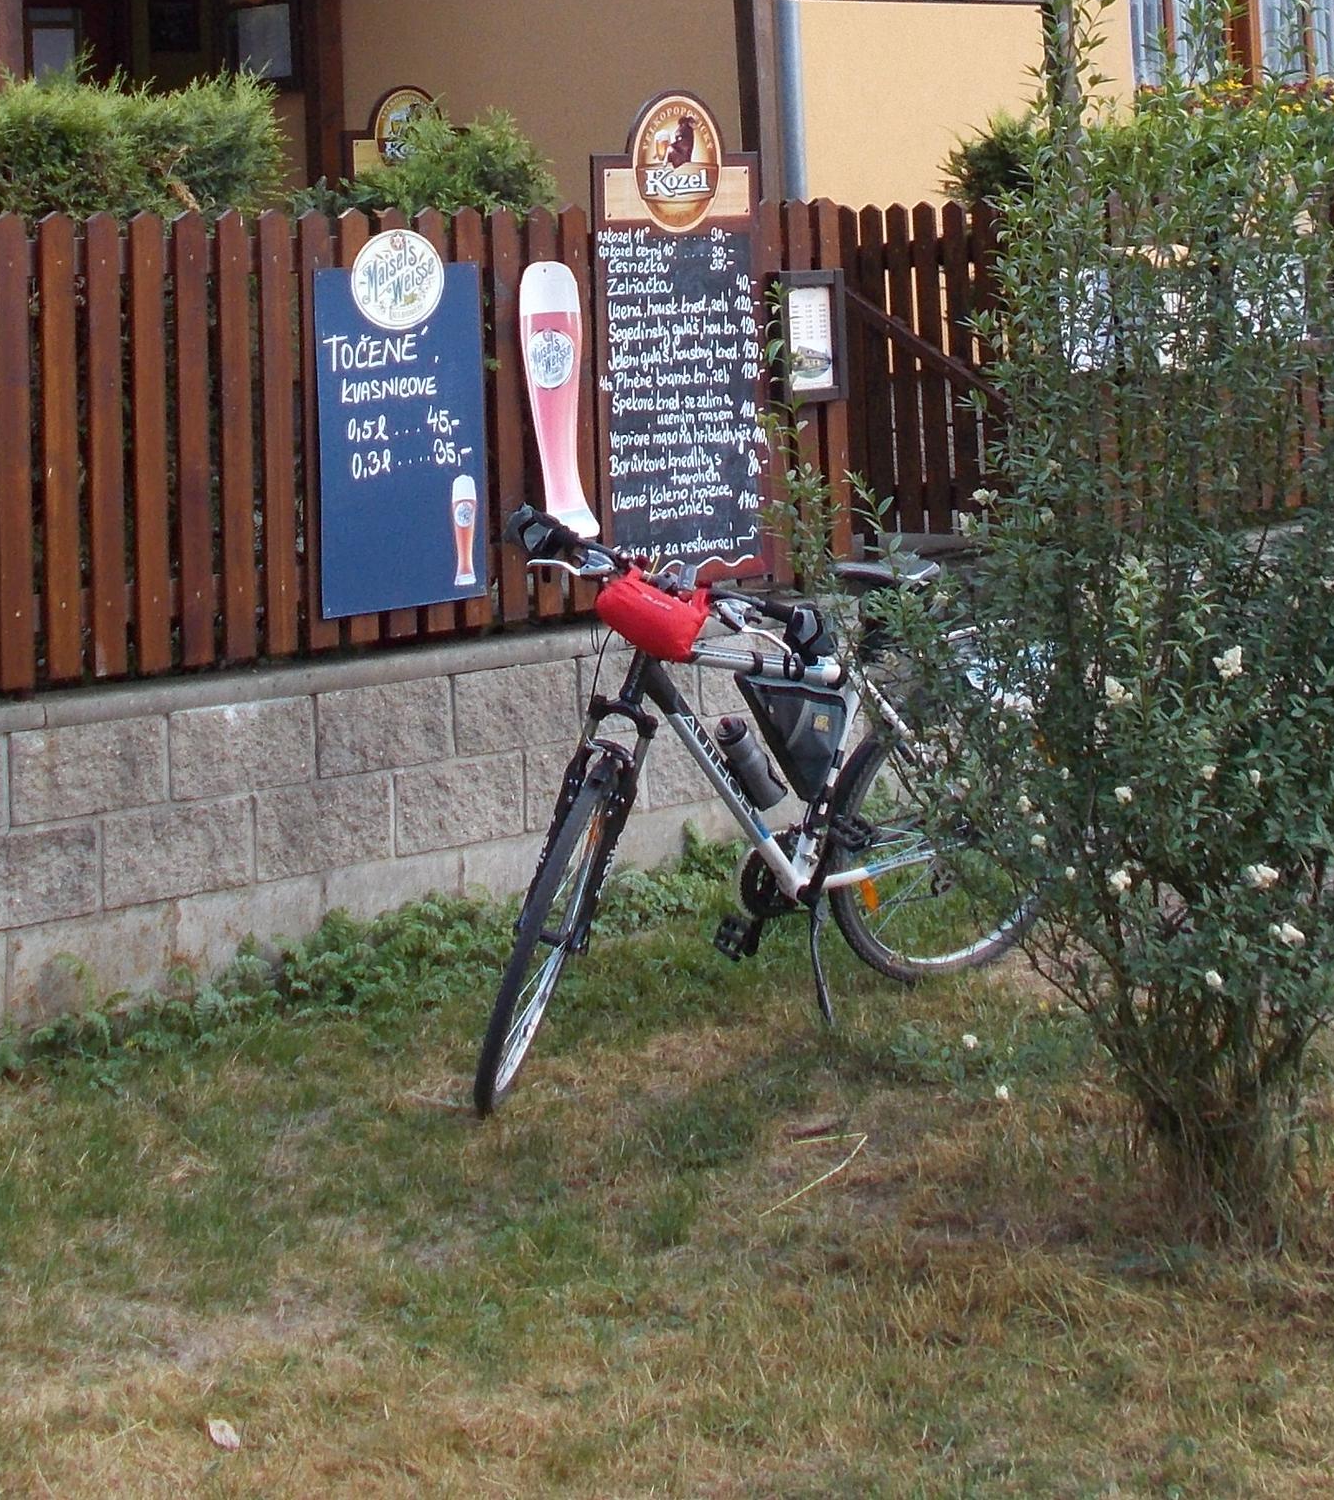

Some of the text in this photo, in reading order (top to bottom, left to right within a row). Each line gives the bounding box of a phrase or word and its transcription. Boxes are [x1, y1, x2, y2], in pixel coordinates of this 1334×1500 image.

[644, 168, 711, 198] Kozel
[362, 239, 418, 305] Maisel's
[386, 257, 435, 306] Weisse
[606, 274, 674, 296] Zelňačka
[607, 258, 670, 274] Česnečka
[322, 325, 430, 373] TOČENÉ
